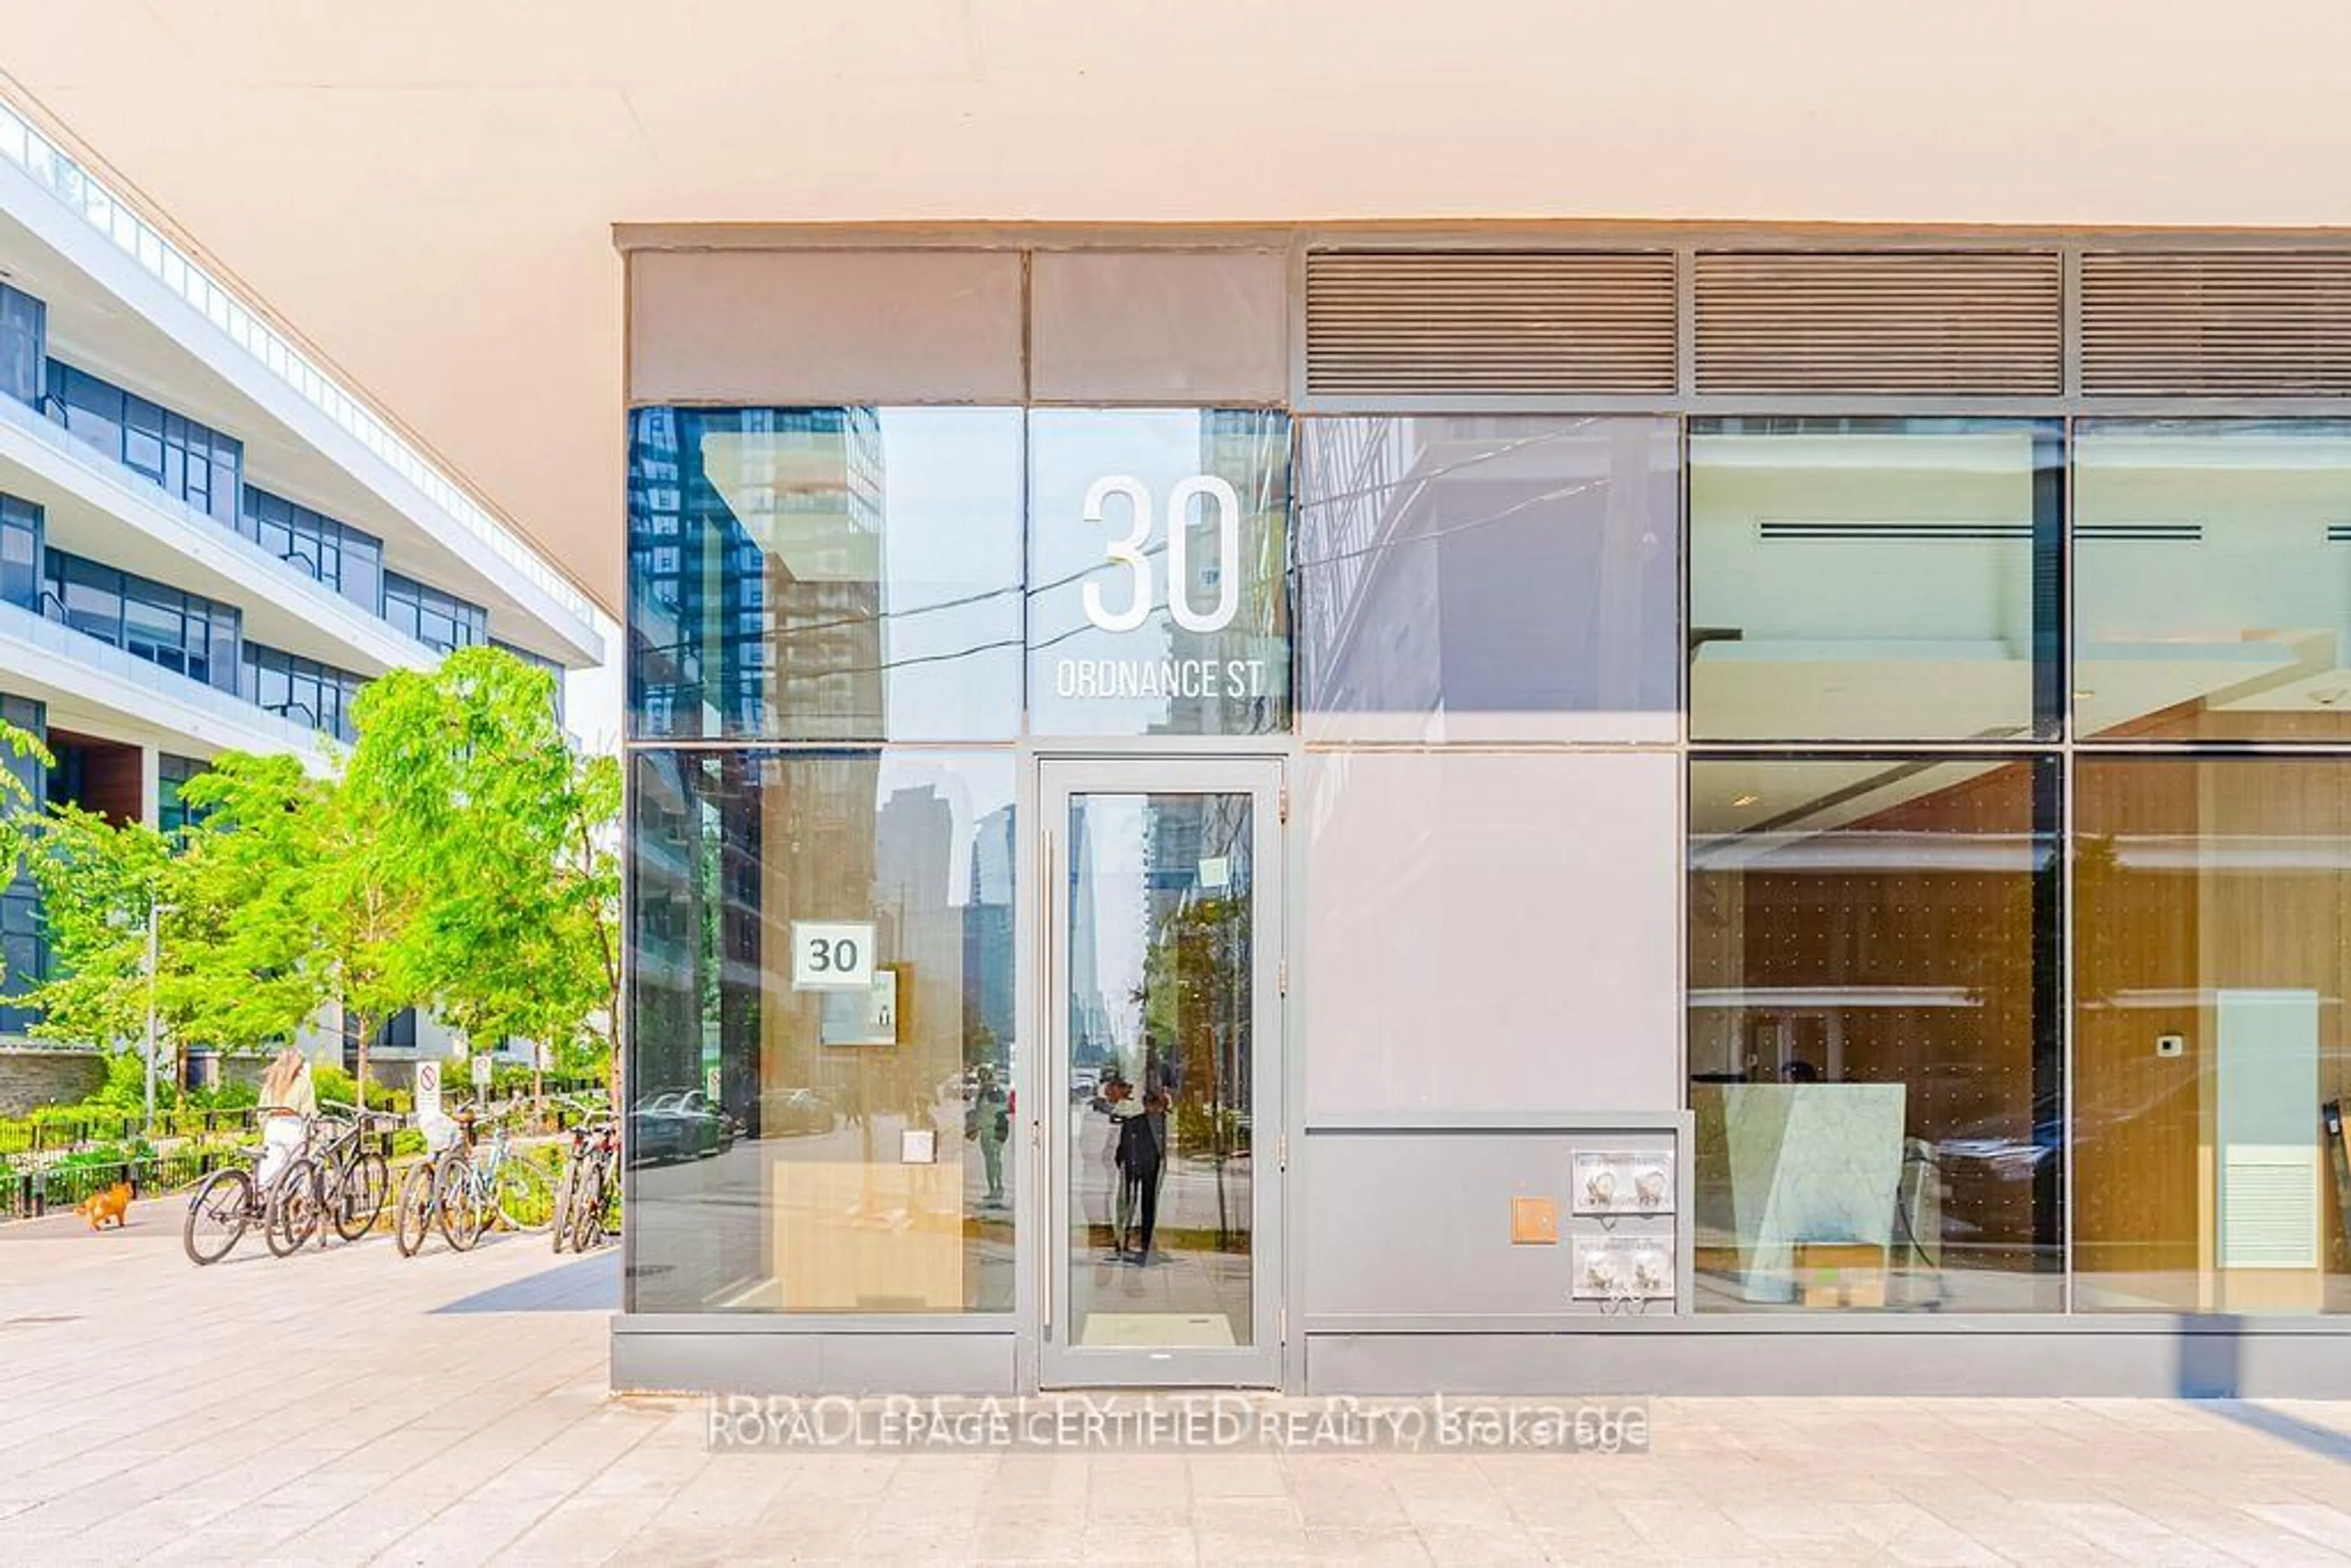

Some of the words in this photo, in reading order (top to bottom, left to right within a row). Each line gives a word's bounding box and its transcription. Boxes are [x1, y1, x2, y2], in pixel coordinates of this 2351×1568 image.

[1082, 475, 1239, 632] 30
[1057, 660, 1218, 697] ORDNANCE
[1227, 660, 1264, 697] ST
[808, 938, 858, 972] 30
